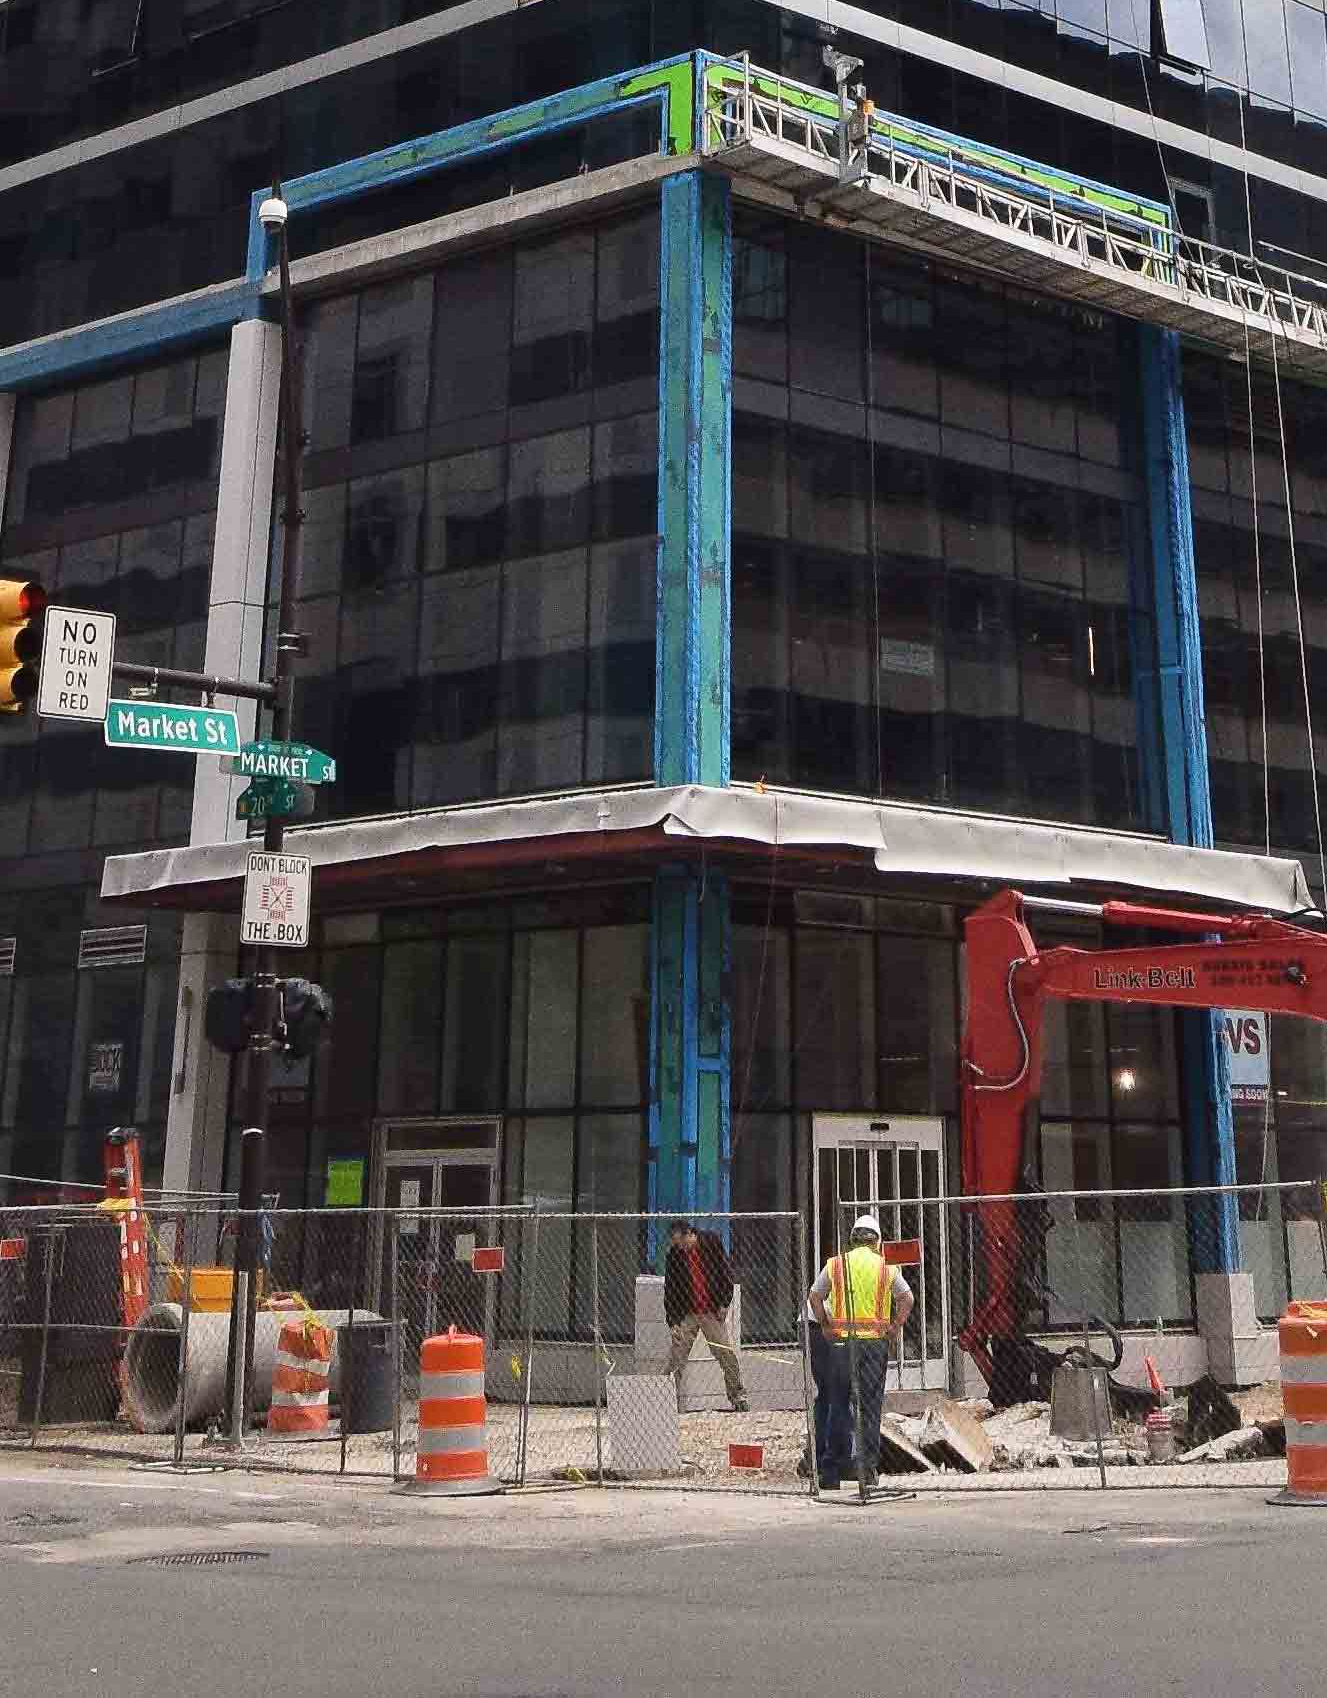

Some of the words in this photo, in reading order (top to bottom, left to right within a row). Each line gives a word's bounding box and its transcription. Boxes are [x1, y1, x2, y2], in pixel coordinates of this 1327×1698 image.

[63, 620, 97, 644] NO
[59, 648, 98, 668] TURN
[65, 671, 87, 689] ON
[59, 692, 89, 711] RED
[118, 710, 198, 742] Market
[206, 721, 228, 745] St
[240, 753, 309, 777] MARKET
[278, 858, 307, 876] BLOCK
[247, 921, 271, 941] THE
[277, 923, 304, 942] BOX
[1223, 1017, 1262, 1055] VS
